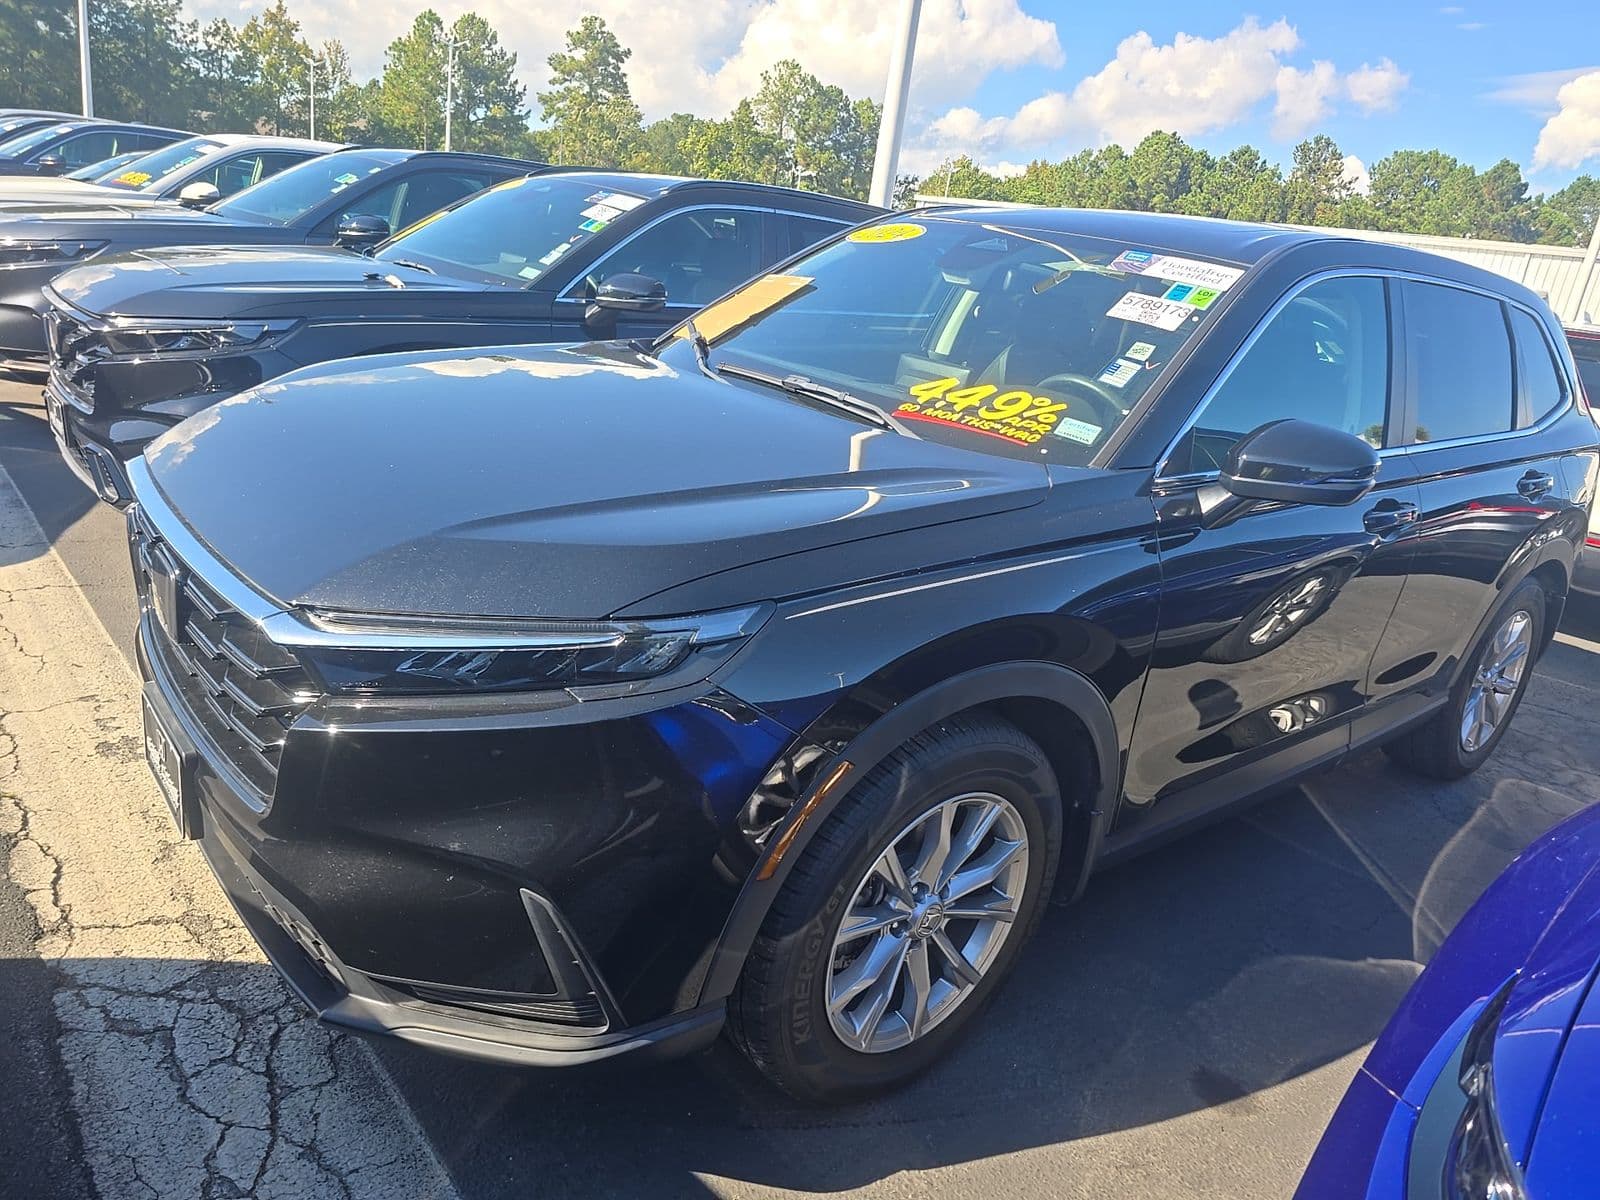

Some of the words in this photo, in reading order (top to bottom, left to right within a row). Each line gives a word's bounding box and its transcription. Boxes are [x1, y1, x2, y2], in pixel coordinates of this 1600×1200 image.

[1161, 268, 1223, 286] Certified
[1122, 295, 1191, 319] 5789173
[898, 402, 921, 412] 60
[1002, 416, 1052, 435] APR
